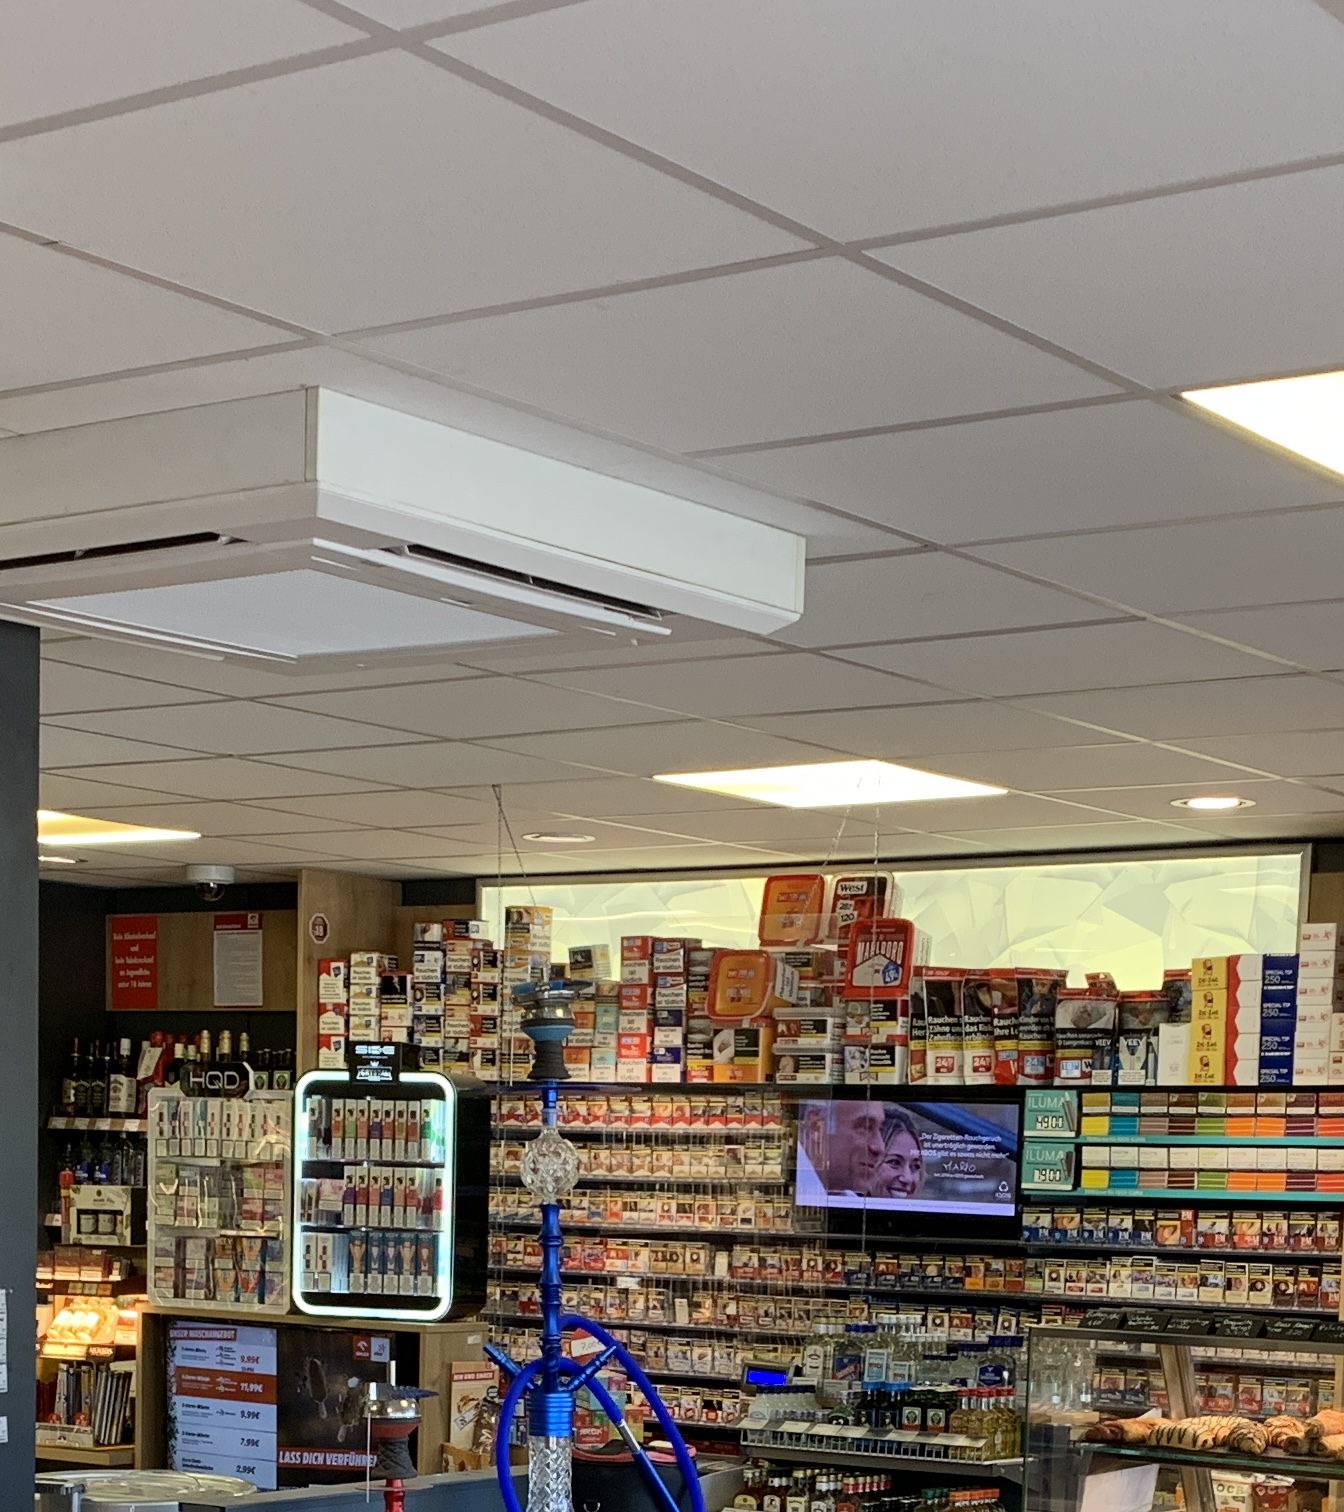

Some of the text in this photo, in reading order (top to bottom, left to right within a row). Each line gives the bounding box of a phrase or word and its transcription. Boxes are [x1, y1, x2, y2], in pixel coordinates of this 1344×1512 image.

[840, 883, 864, 893] West
[857, 940, 903, 964] MARLBORO
[1265, 976, 1281, 984] 250
[1262, 1009, 1279, 1017] 250
[994, 1017, 1018, 1026] Rauch
[1261, 1041, 1278, 1050] 250
[189, 1071, 240, 1090] HQD
[1259, 1075, 1276, 1083] 250
[279, 1451, 377, 1467] LASS DICH VERFÜHRE
